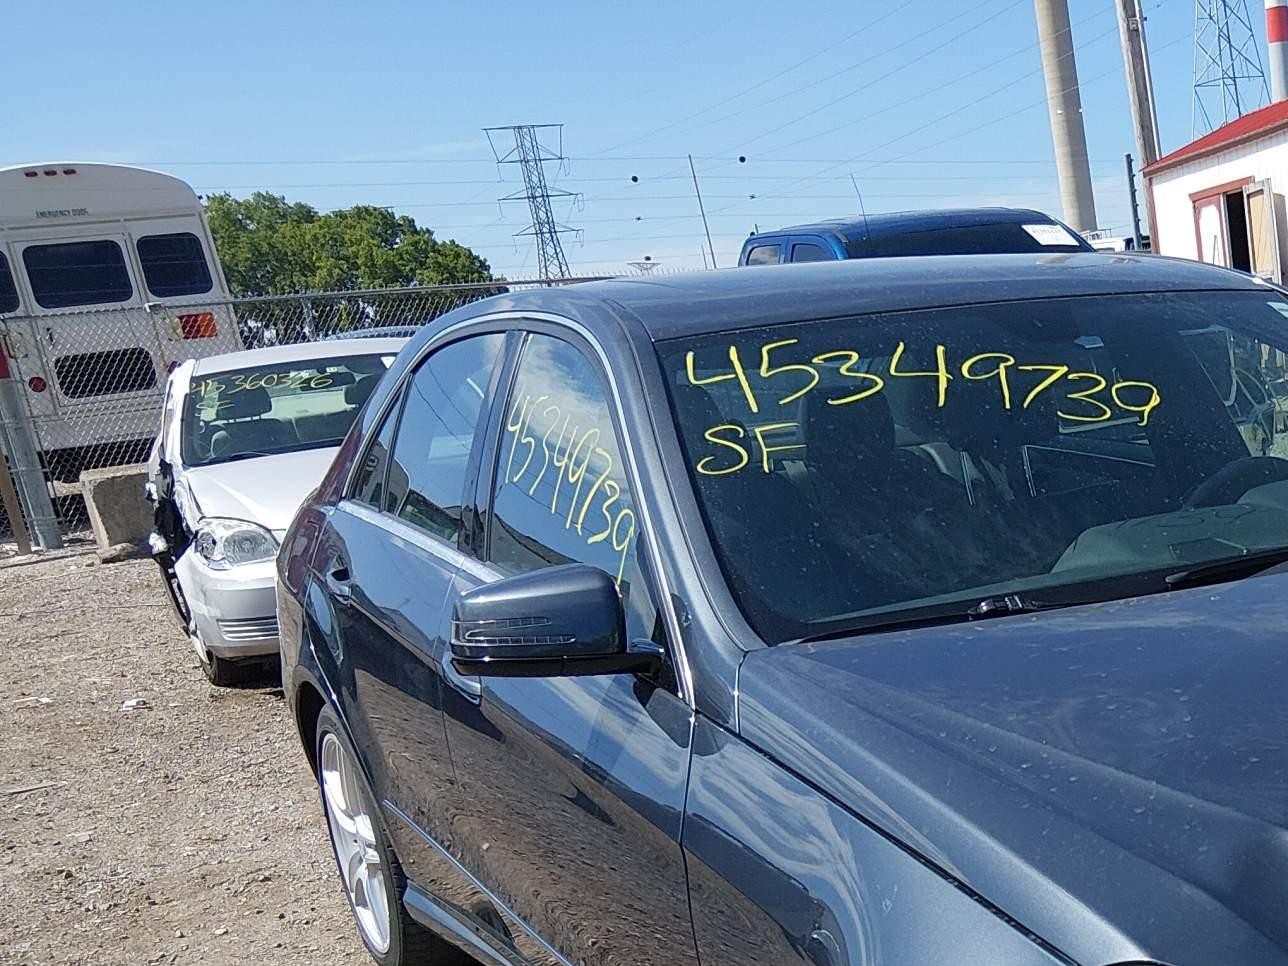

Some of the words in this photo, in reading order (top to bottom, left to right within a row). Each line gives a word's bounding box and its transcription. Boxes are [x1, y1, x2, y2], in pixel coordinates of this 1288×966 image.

[685, 338, 1161, 427] 45349739
[505, 384, 636, 588] 45349739
[696, 422, 807, 475] SF
